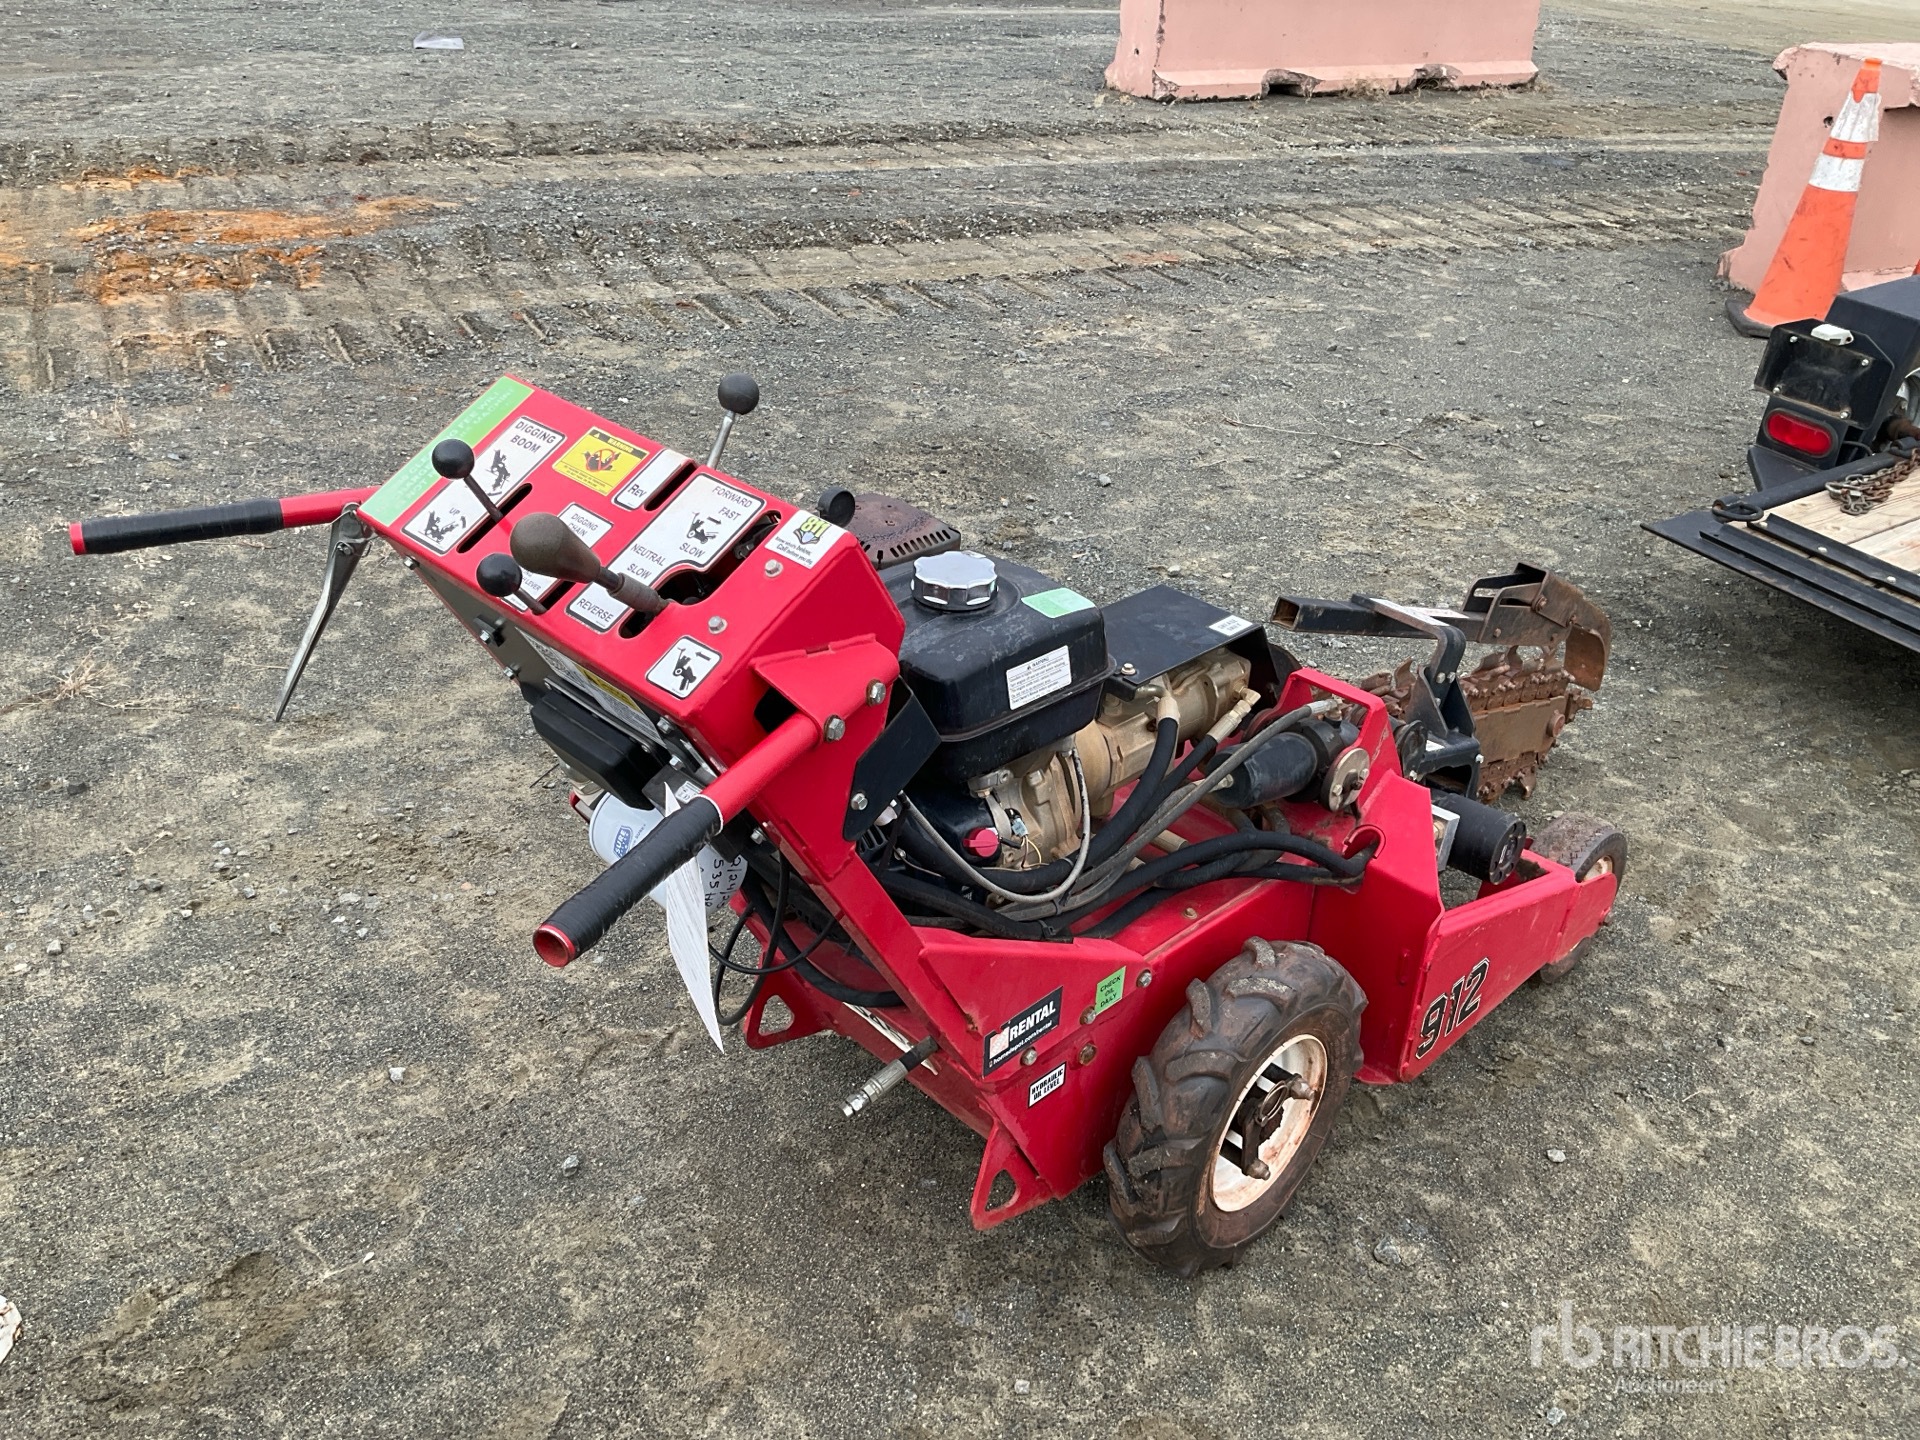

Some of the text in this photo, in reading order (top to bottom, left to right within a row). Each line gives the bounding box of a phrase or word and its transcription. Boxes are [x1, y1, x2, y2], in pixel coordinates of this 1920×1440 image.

[515, 421, 556, 444] DIGGING
[510, 434, 541, 453] BOOM
[712, 485, 753, 508] FORWARD
[571, 513, 598, 531] DIGGING
[718, 506, 741, 521] FAST
[800, 515, 832, 538] 811
[630, 543, 666, 567] NEUTRAL
[679, 542, 706, 558] SLOW
[627, 563, 652, 580] SLOW
[525, 578, 542, 592] LEVER
[577, 598, 614, 623] REVERSE
[615, 827, 628, 856] SURE
[709, 859, 724, 889] 535
[1100, 975, 1121, 992] CHECK
[1104, 988, 1114, 997] OIL
[1100, 992, 1117, 1008] DAILY
[1415, 957, 1490, 1060] 912
[1009, 1001, 1056, 1042] RENTAL
[1031, 1067, 1064, 1094] HYDRAULIC
[1043, 1078, 1060, 1094] LEVEL
